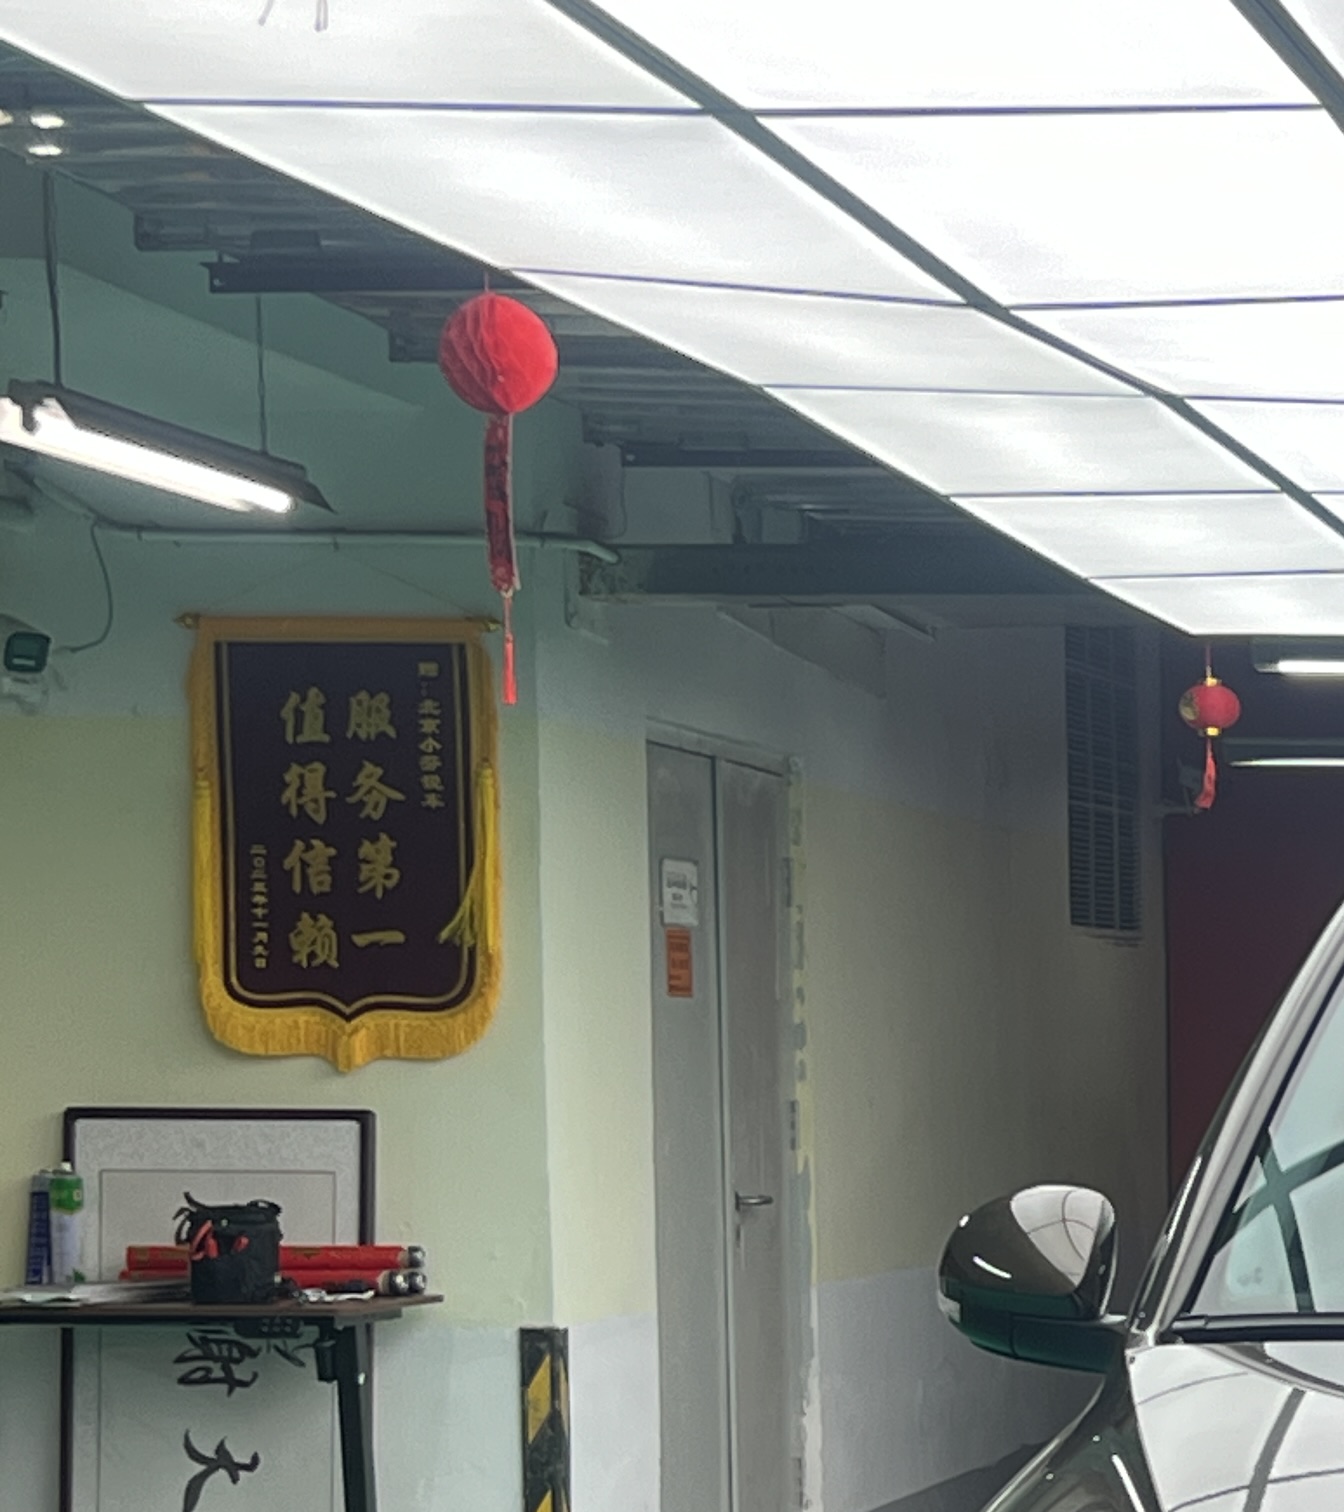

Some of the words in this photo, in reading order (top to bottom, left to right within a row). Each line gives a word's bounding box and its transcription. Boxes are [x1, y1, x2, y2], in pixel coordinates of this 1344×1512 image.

[280, 686, 339, 969] 值得信赖
[345, 690, 406, 949] 服务第一
